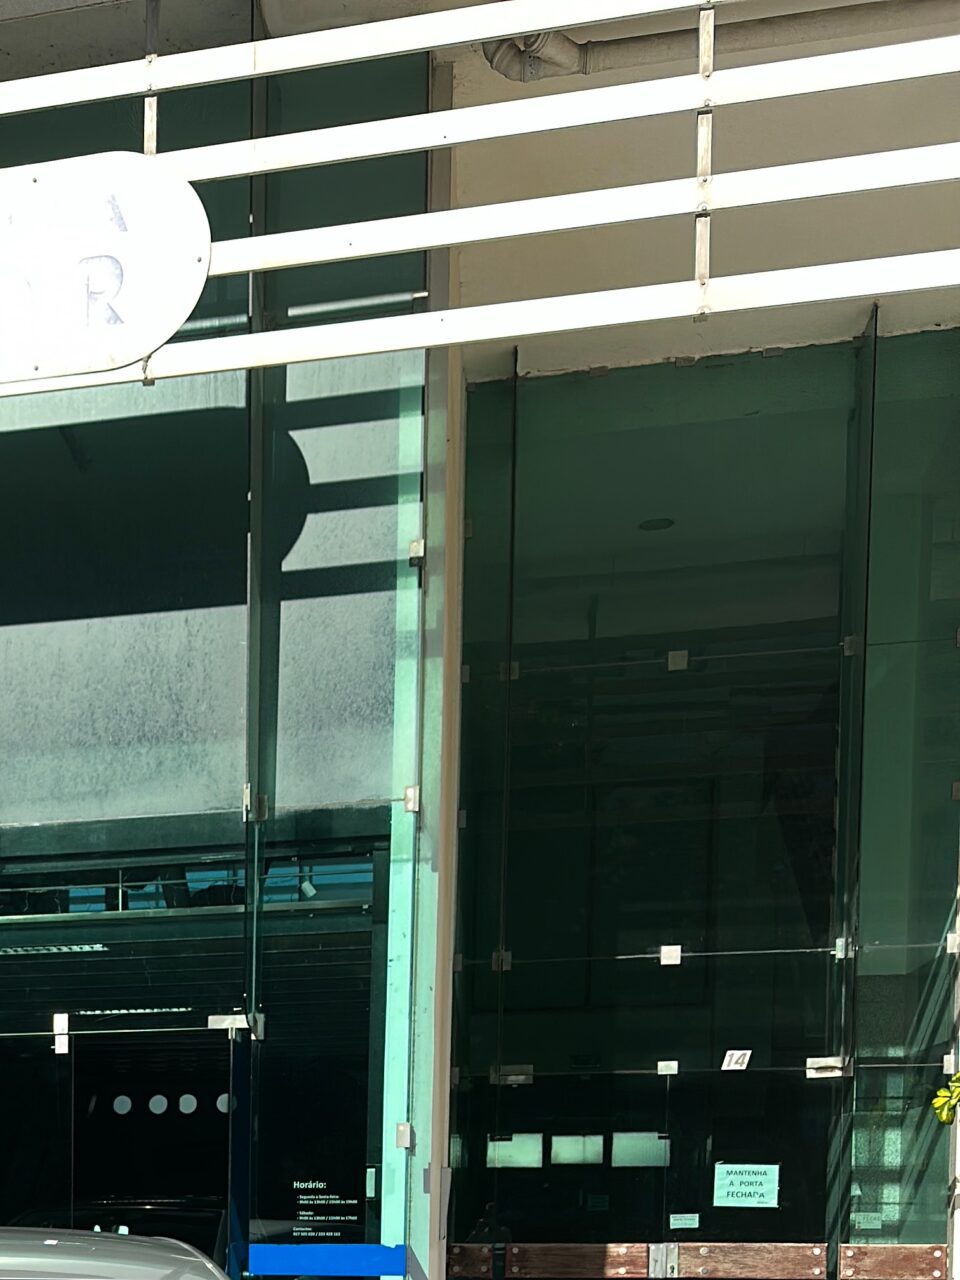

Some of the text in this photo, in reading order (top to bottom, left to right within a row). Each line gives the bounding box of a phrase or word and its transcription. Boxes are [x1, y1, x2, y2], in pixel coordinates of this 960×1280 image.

[726, 1052, 748, 1068] 14
[725, 1169, 768, 1177] MANTENHA
[293, 1181, 327, 1189] Horário:
[739, 1180, 764, 1188] PORTA
